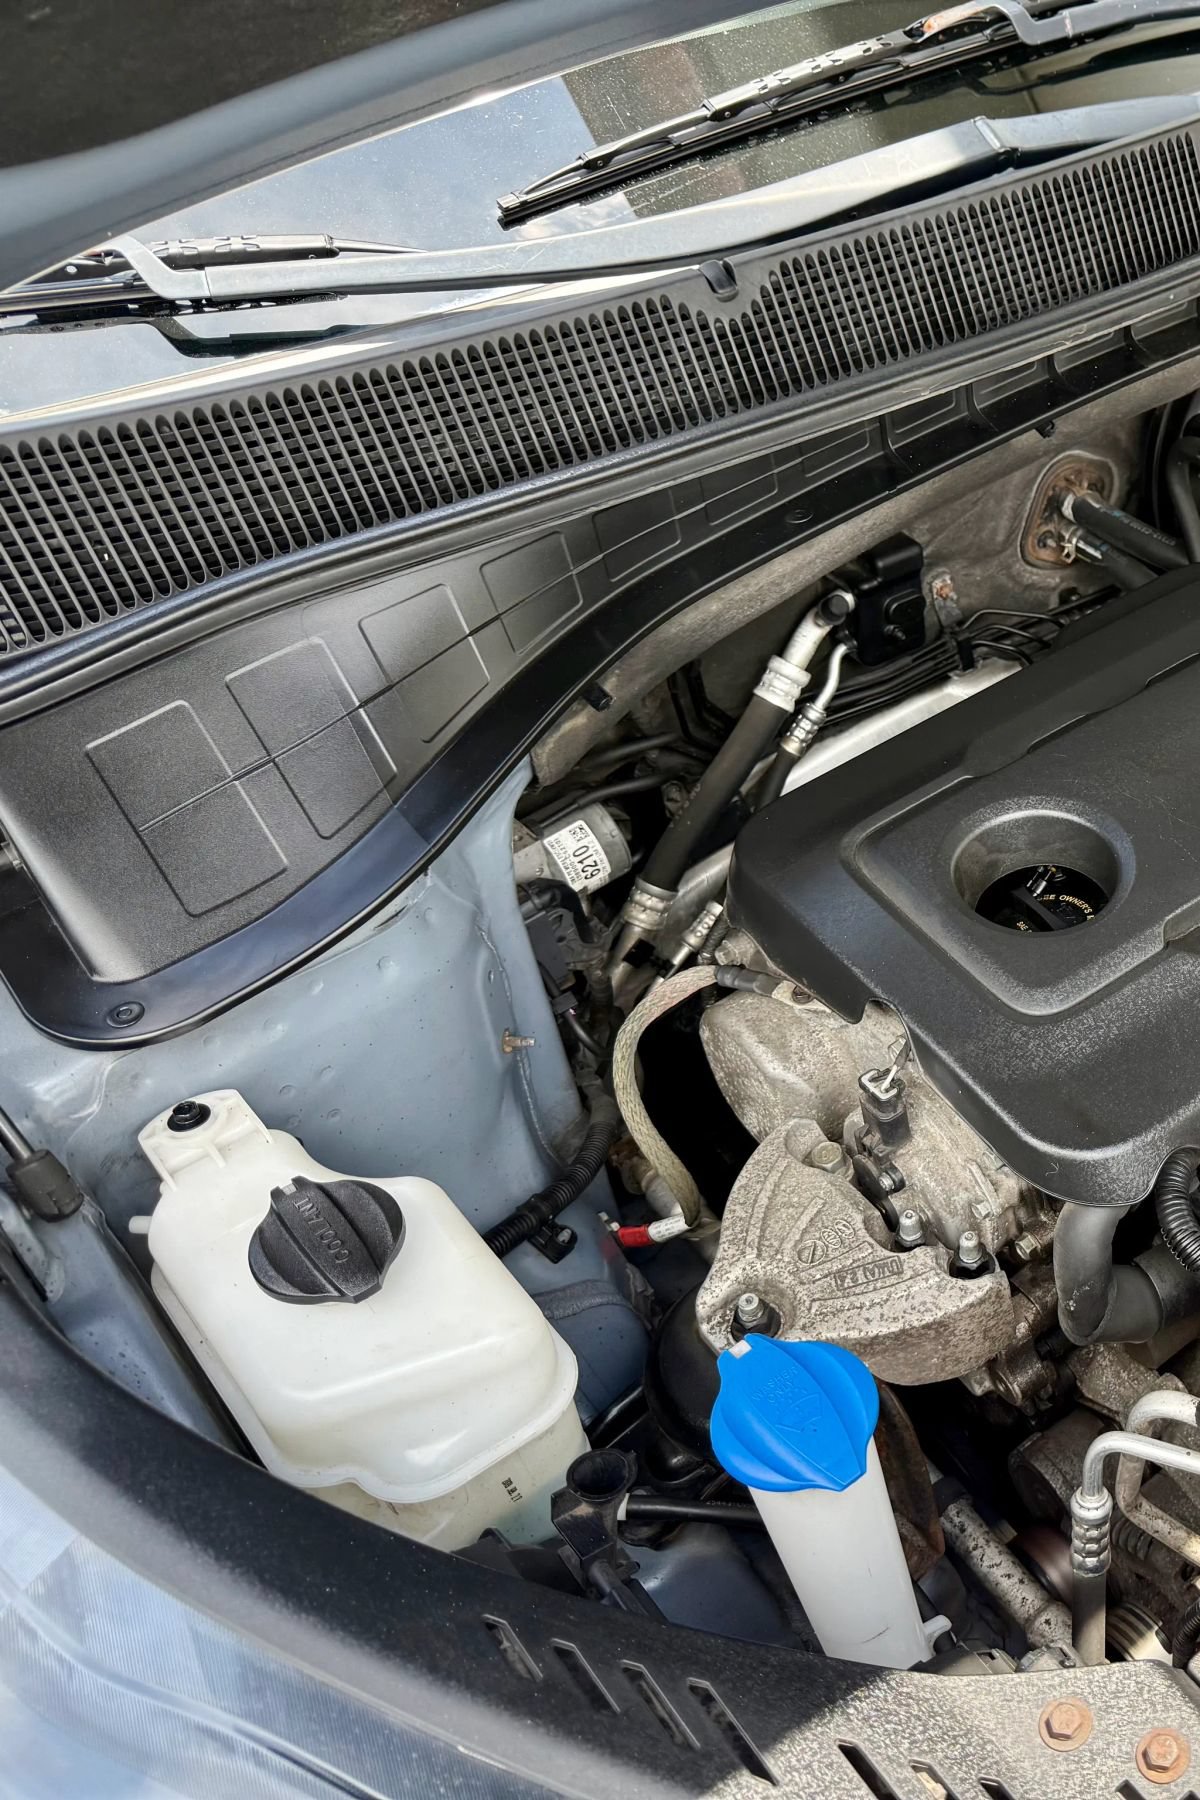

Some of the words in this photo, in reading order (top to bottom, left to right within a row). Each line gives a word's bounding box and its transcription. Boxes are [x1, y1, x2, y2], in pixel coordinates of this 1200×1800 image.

[573, 845, 601, 880] 6210
[1059, 894, 1093, 914] OWNER'S
[293, 1196, 351, 1265] COOLANT
[751, 1366, 800, 1402] WASHER
